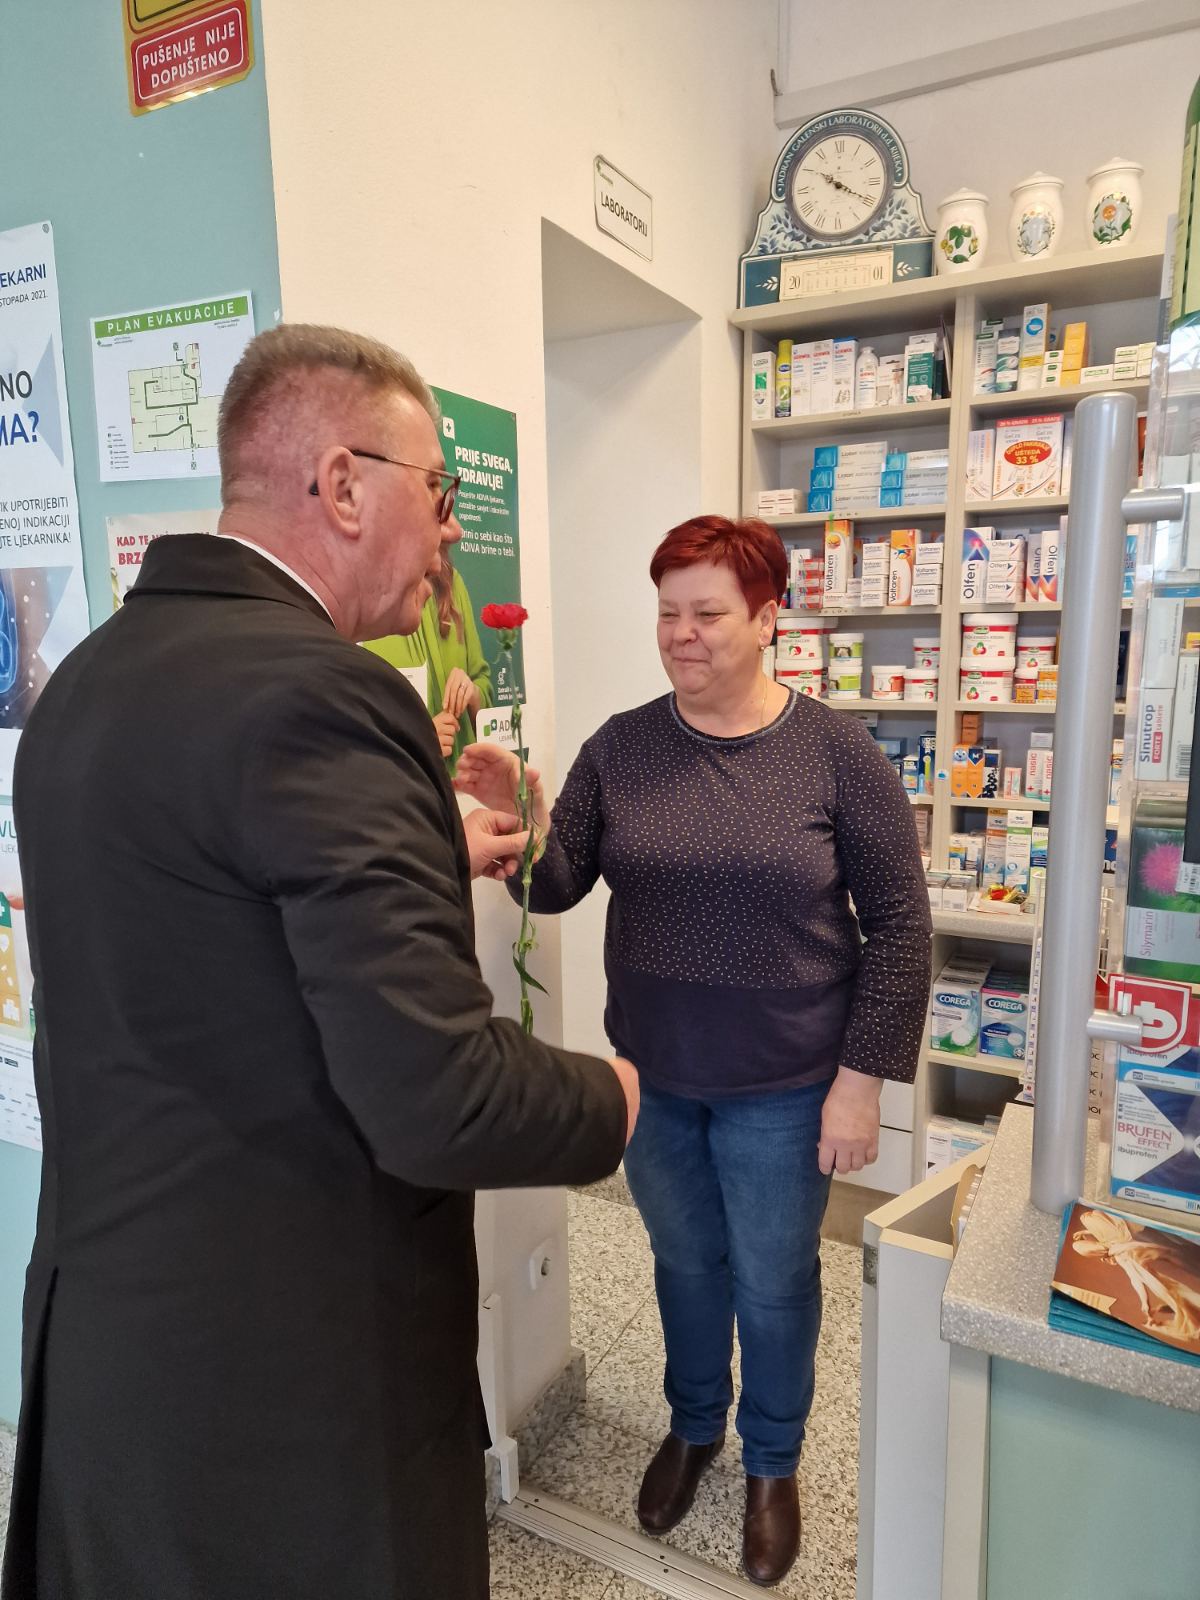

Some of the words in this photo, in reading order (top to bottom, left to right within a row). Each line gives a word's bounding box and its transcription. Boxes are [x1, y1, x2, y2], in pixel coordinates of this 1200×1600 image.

[142, 36, 196, 70] PUŠENJE
[205, 21, 236, 46] NIJE
[151, 47, 230, 89] DOPUŠTENO
[791, 120, 828, 151] GALENSKI
[600, 191, 648, 238] LABORATORIJ
[107, 318, 145, 333] PLAN
[147, 302, 235, 327] EVAKUACIJE
[455, 445, 480, 467] PRIJE
[482, 452, 513, 474] SVEGA,
[1015, 456, 1027, 465] 33
[1029, 455, 1039, 464] %
[457, 466, 503, 491] ZDRAVLJE!
[11, 496, 69, 511] UPOTRIJEBITI
[23, 514, 70, 528] INDIKACIJI
[14, 532, 72, 548] LJEKARNIKA!
[116, 535, 136, 547] KAD
[138, 535, 149, 546] TE
[118, 551, 145, 566] BRZ
[1047, 545, 1058, 573] Olfen
[825, 554, 834, 592] Voltaren
[963, 562, 976, 599] Olfen
[890, 570, 898, 603] Voltaren
[1140, 704, 1156, 762] Sinutrop
[1153, 735, 1162, 760] FORTE
[939, 994, 972, 1006] COREGA
[988, 999, 1023, 1011] COREGA
[1117, 1122, 1172, 1142] BRUFEN
[1137, 1137, 1171, 1151] EFFECT
[1117, 1145, 1158, 1160] ibuprofen
